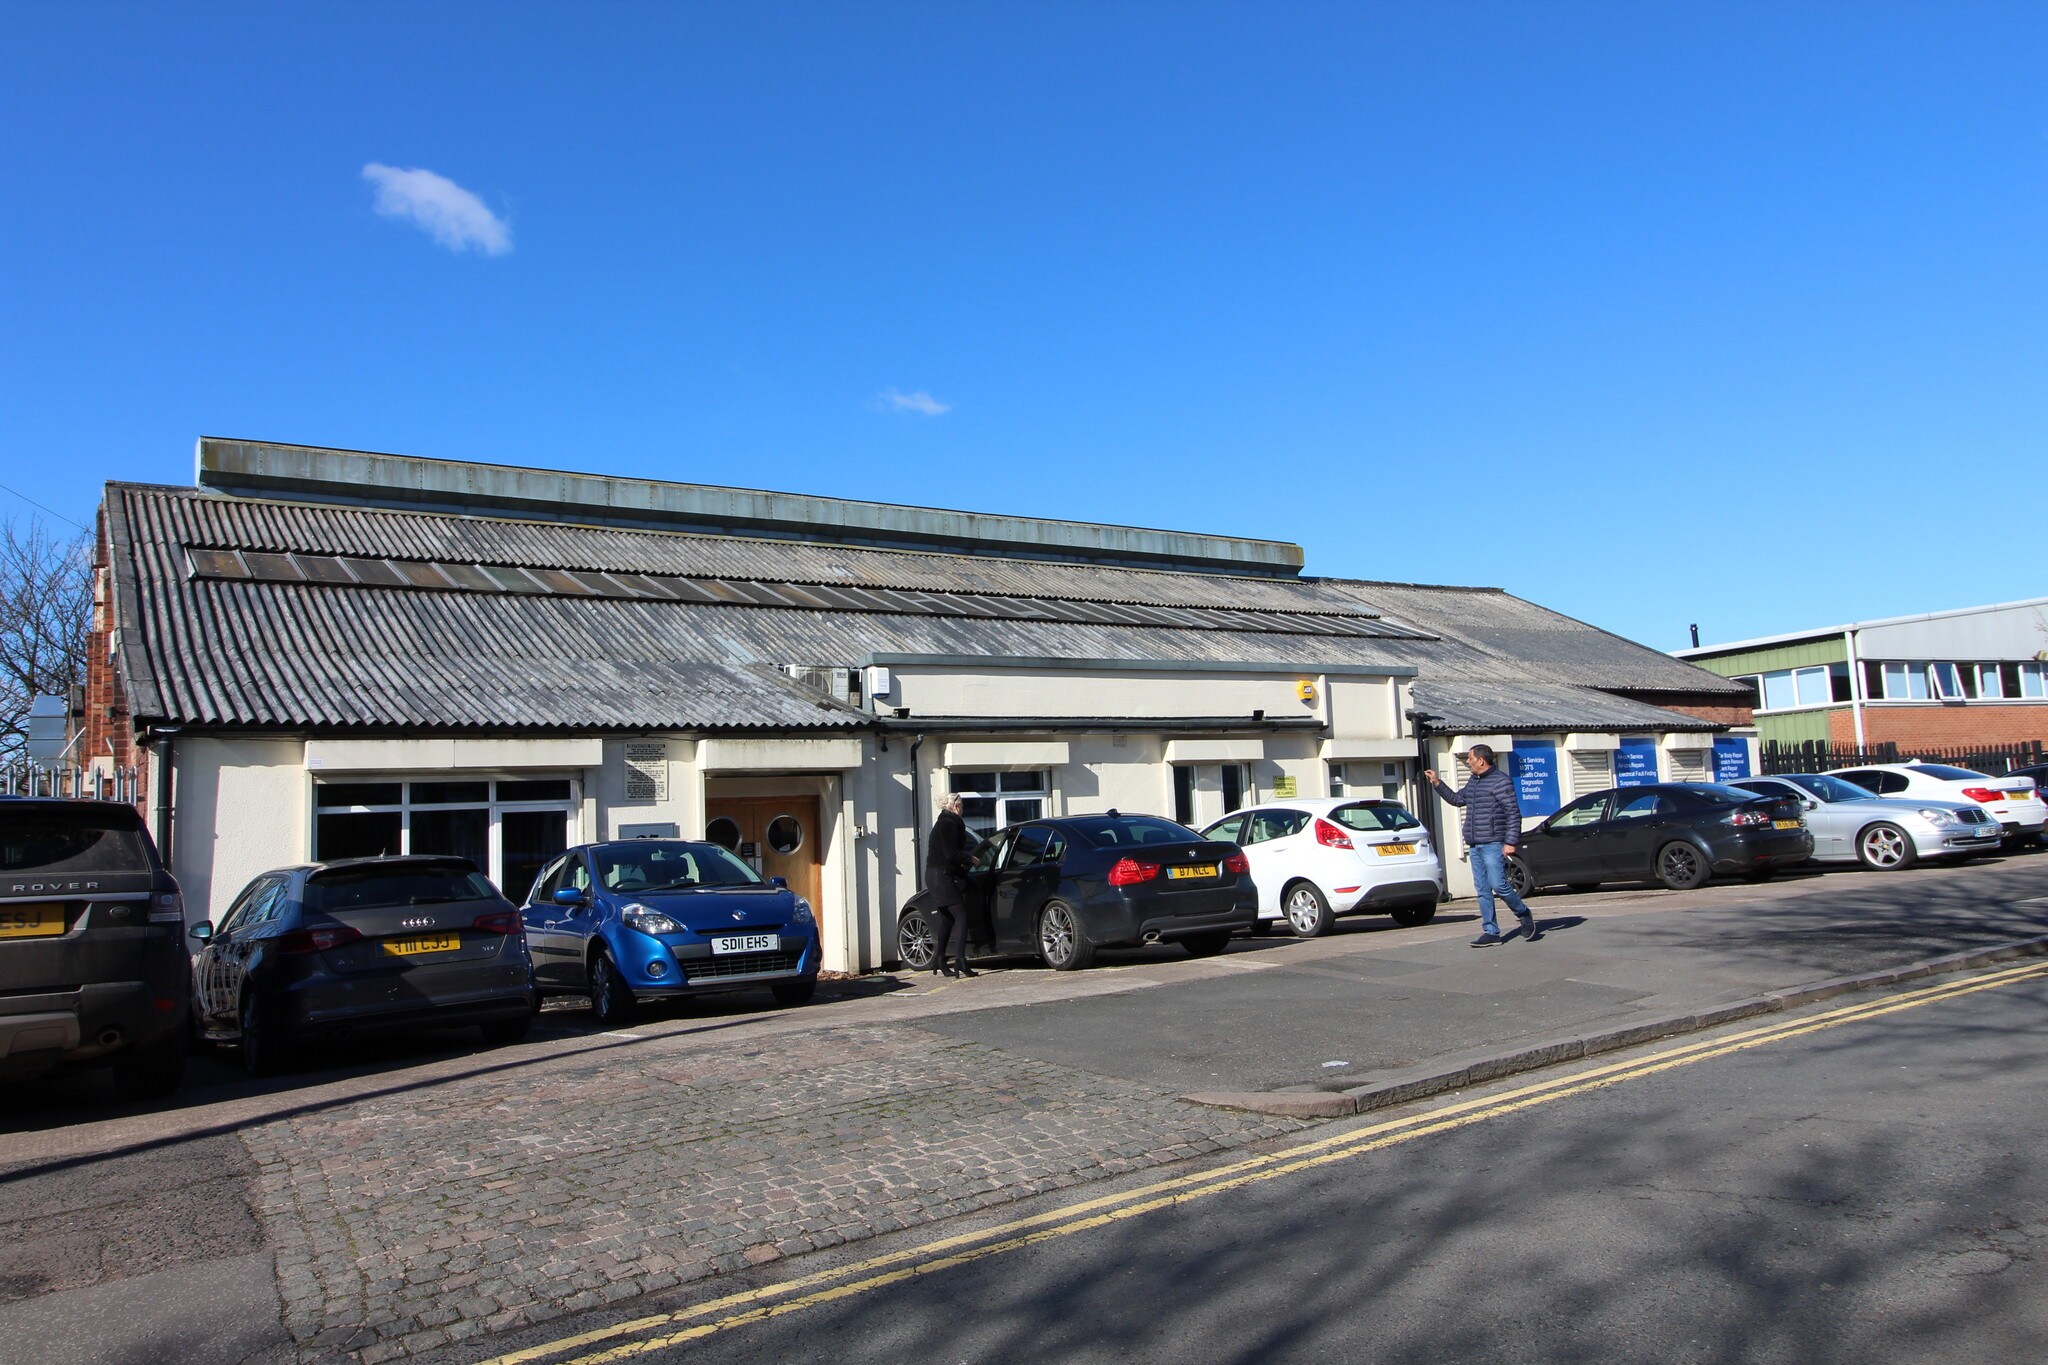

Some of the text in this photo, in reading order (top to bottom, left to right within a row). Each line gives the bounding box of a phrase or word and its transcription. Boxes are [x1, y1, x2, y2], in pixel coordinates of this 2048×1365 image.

[13, 882, 98, 891] ROVER
[421, 935, 450, 950] CJJ
[722, 936, 768, 951] SD11 EHS
